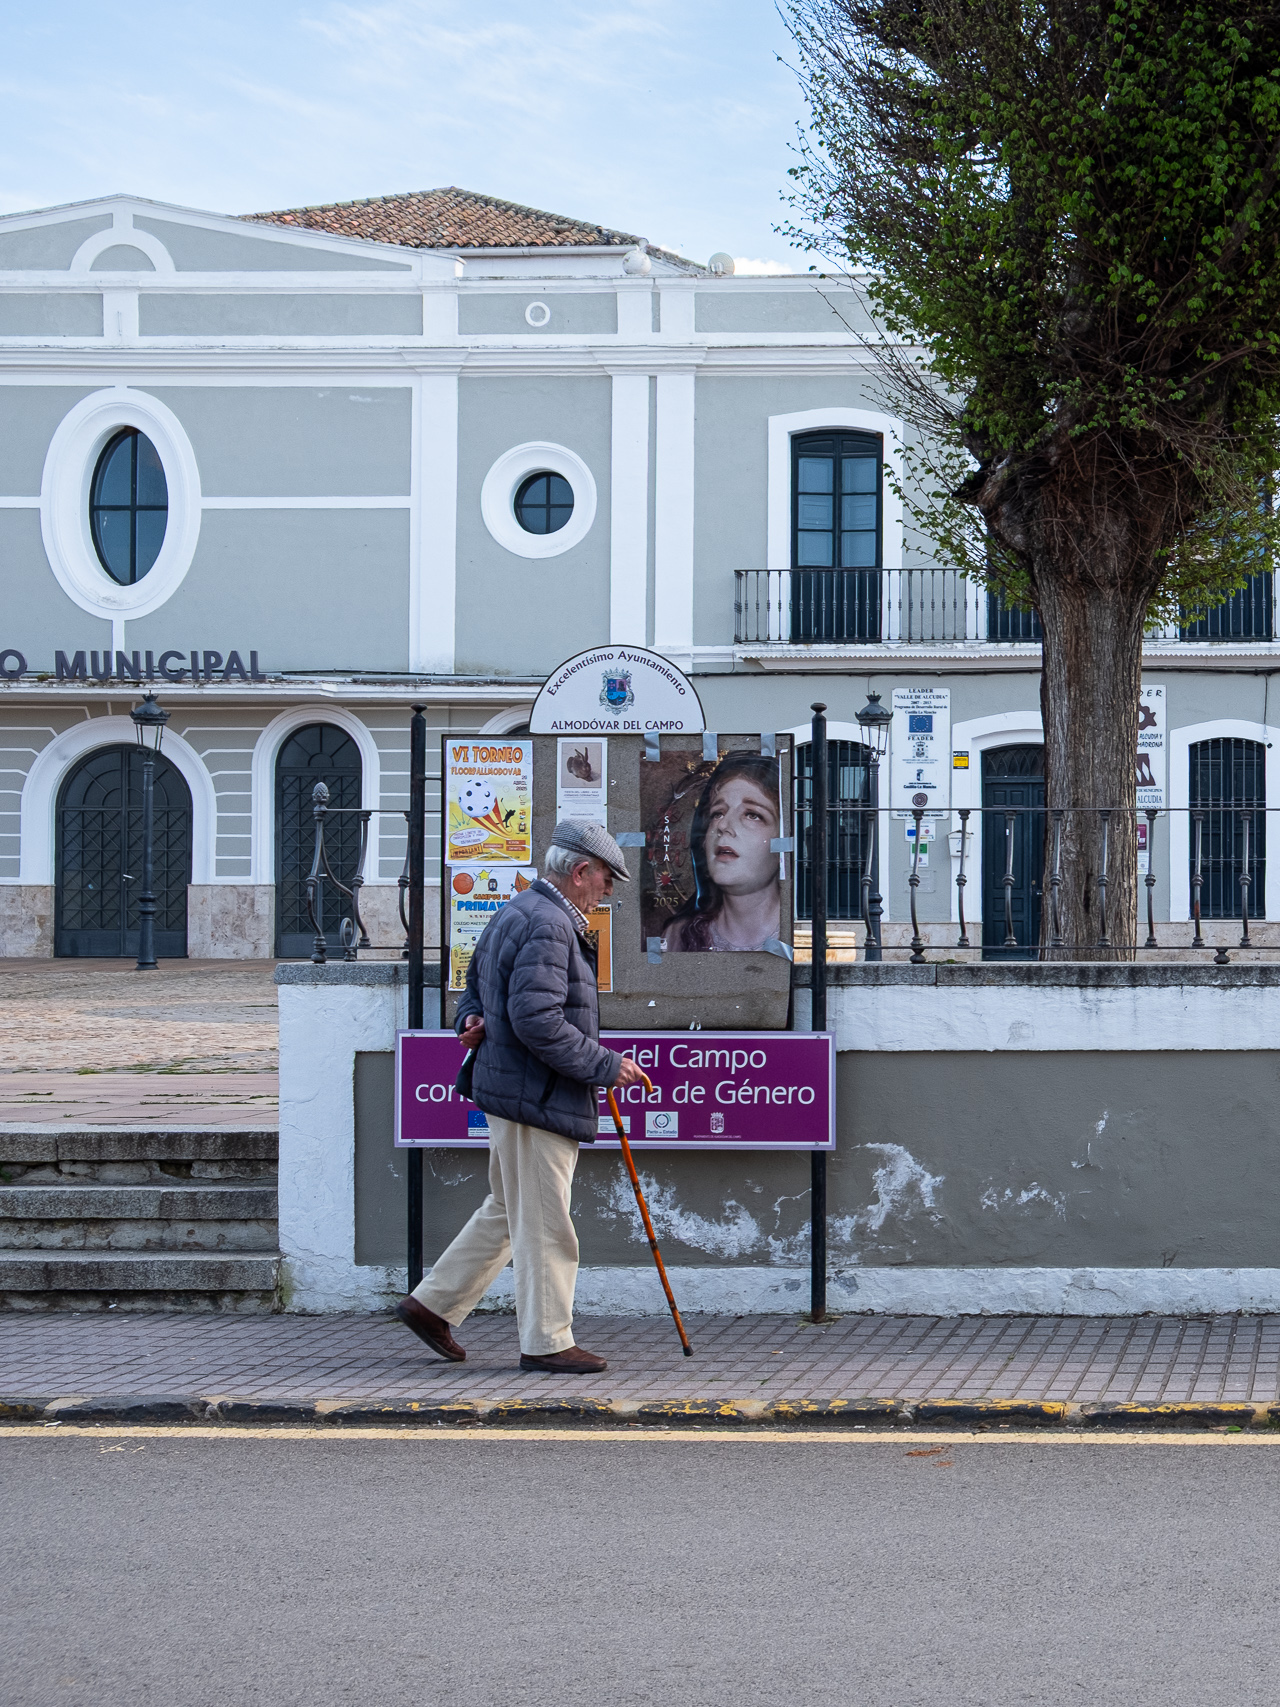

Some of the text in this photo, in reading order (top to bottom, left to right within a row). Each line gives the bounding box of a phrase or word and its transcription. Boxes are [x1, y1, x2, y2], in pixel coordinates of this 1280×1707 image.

[54, 649, 268, 681] MUNICIPAL
[546, 650, 686, 697] Excelentísimo Ayuntamiento
[550, 718, 684, 730] ALMODÓVAR DEL CAMPO
[452, 746, 523, 763] VI TORNEO
[1136, 795, 1163, 804] ALCUDIA
[456, 901, 508, 911] PRIMAV
[653, 896, 679, 908] 2025
[669, 1044, 767, 1075] Campo
[598, 1083, 662, 1104] encia
[671, 1080, 706, 1104] de
[714, 1078, 816, 1105] Género
